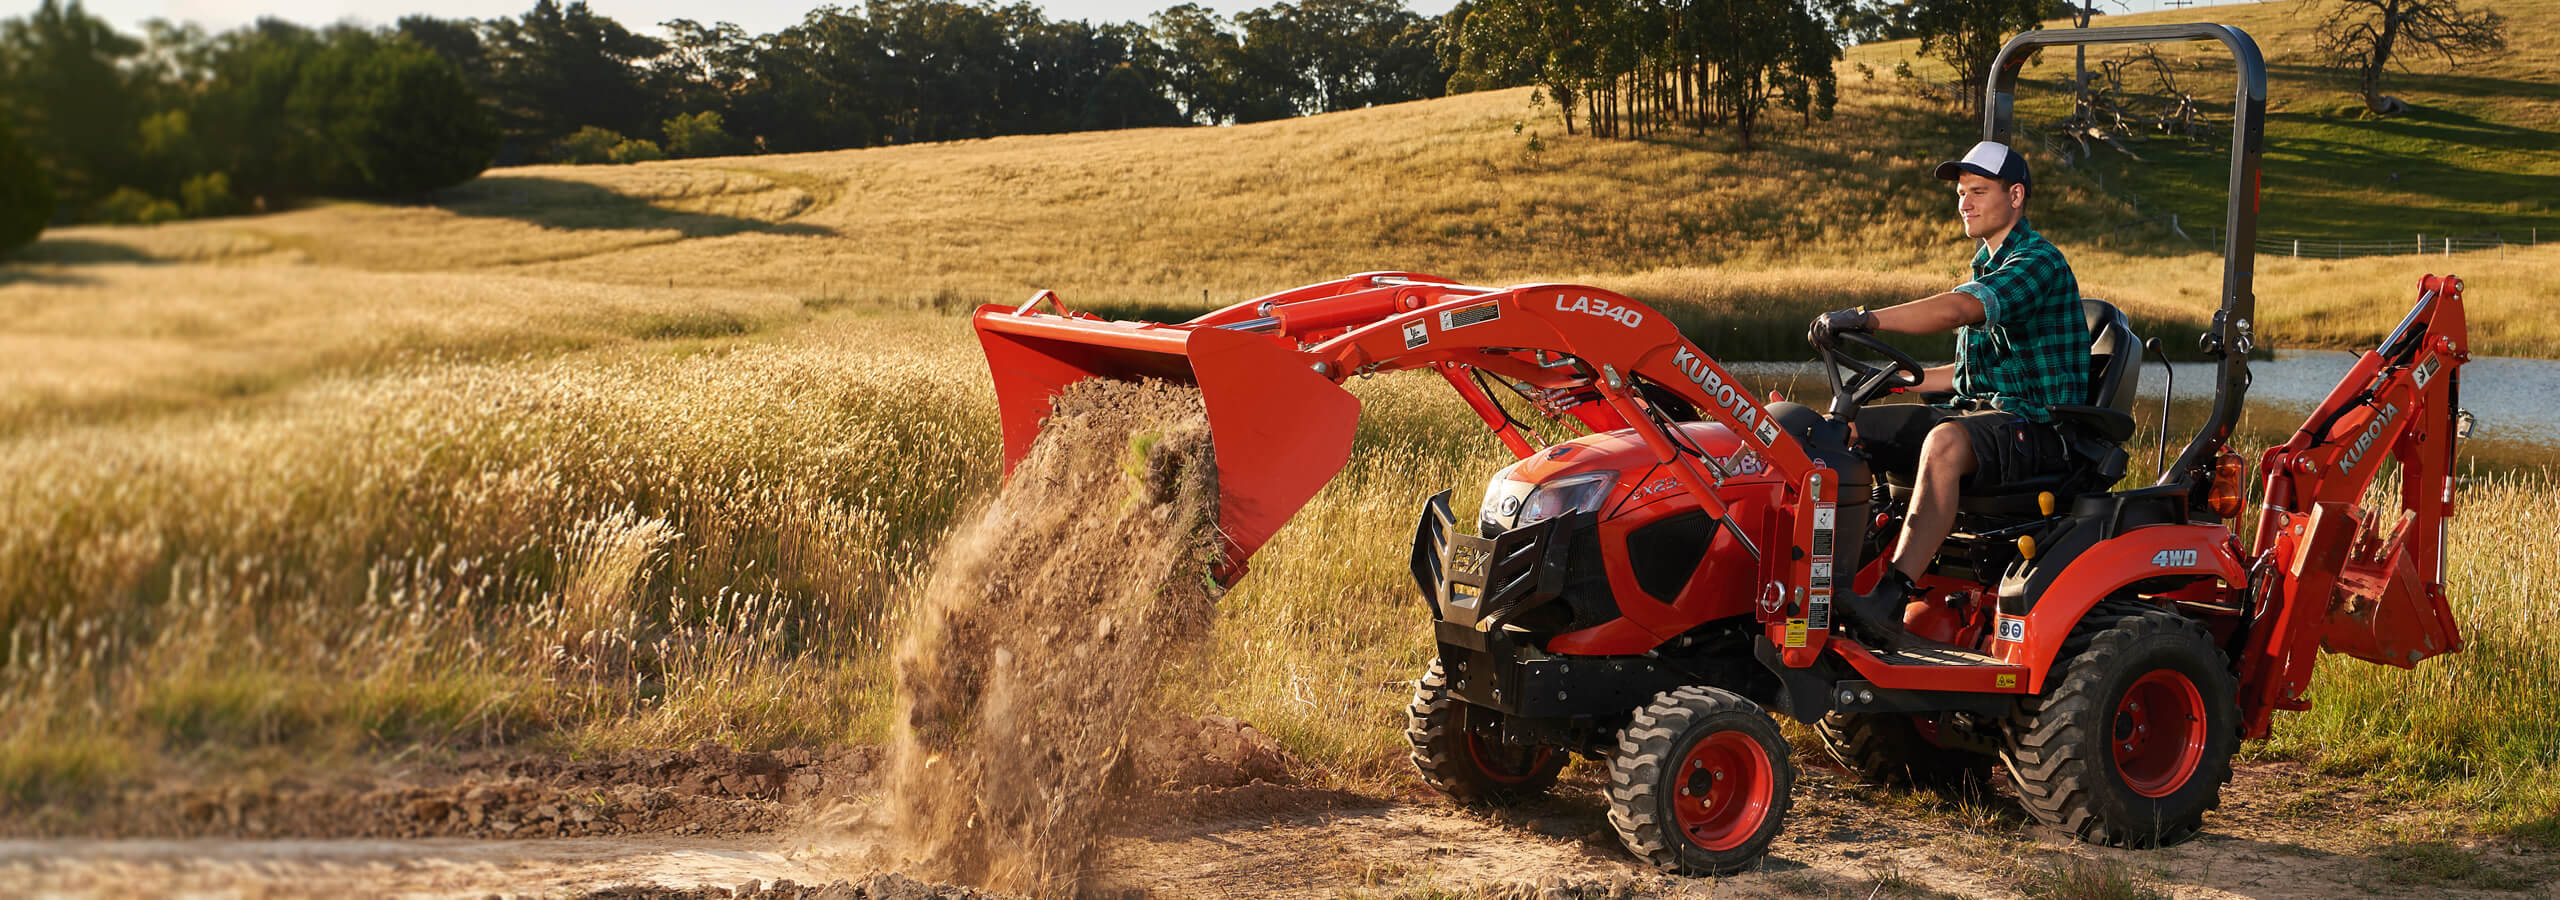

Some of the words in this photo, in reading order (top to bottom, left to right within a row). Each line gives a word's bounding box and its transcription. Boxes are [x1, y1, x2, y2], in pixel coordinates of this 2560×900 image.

[1555, 294, 1643, 328] LA340
[1672, 345, 1757, 432] KUBOTA
[2339, 402, 2399, 475] KUBOTA
[2151, 549, 2198, 568] 4WD
